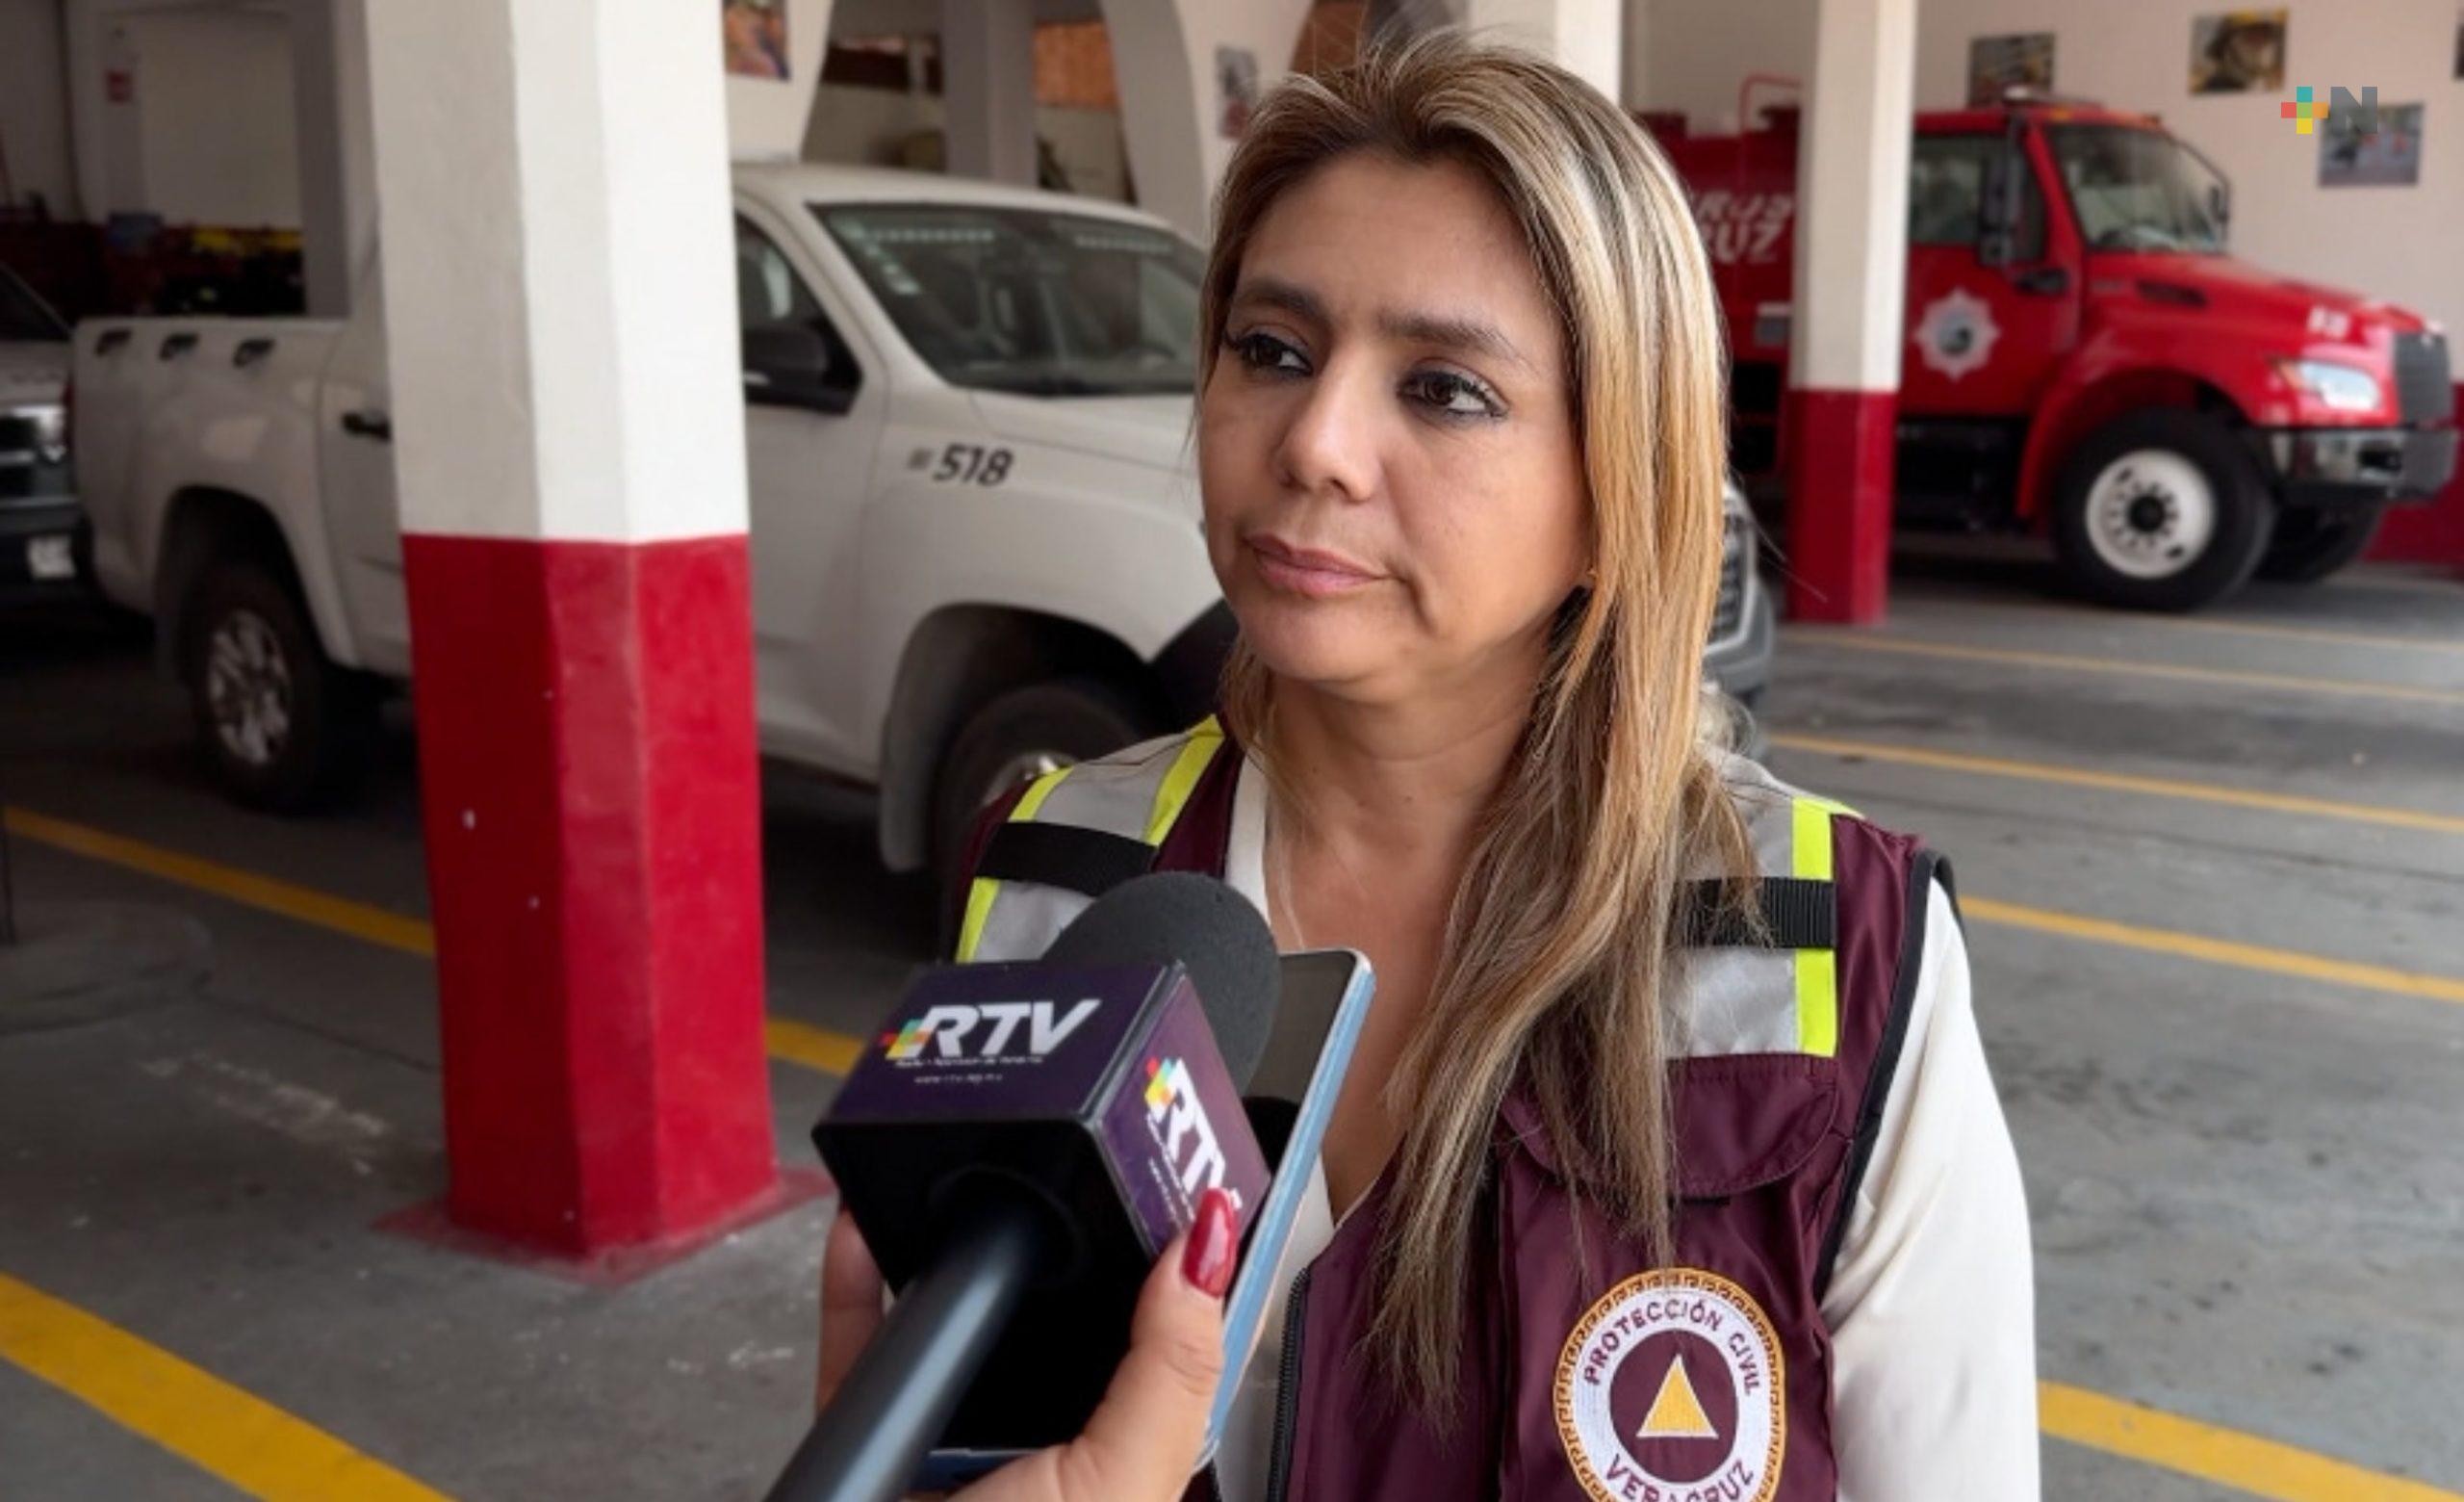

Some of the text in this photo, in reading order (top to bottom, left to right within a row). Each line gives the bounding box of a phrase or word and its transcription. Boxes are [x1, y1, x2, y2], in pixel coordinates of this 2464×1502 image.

[932, 442, 1014, 486] 518
[886, 998, 1102, 1059] RTV
[1584, 1299, 1760, 1397] PROTECCIÓN CIVIL
